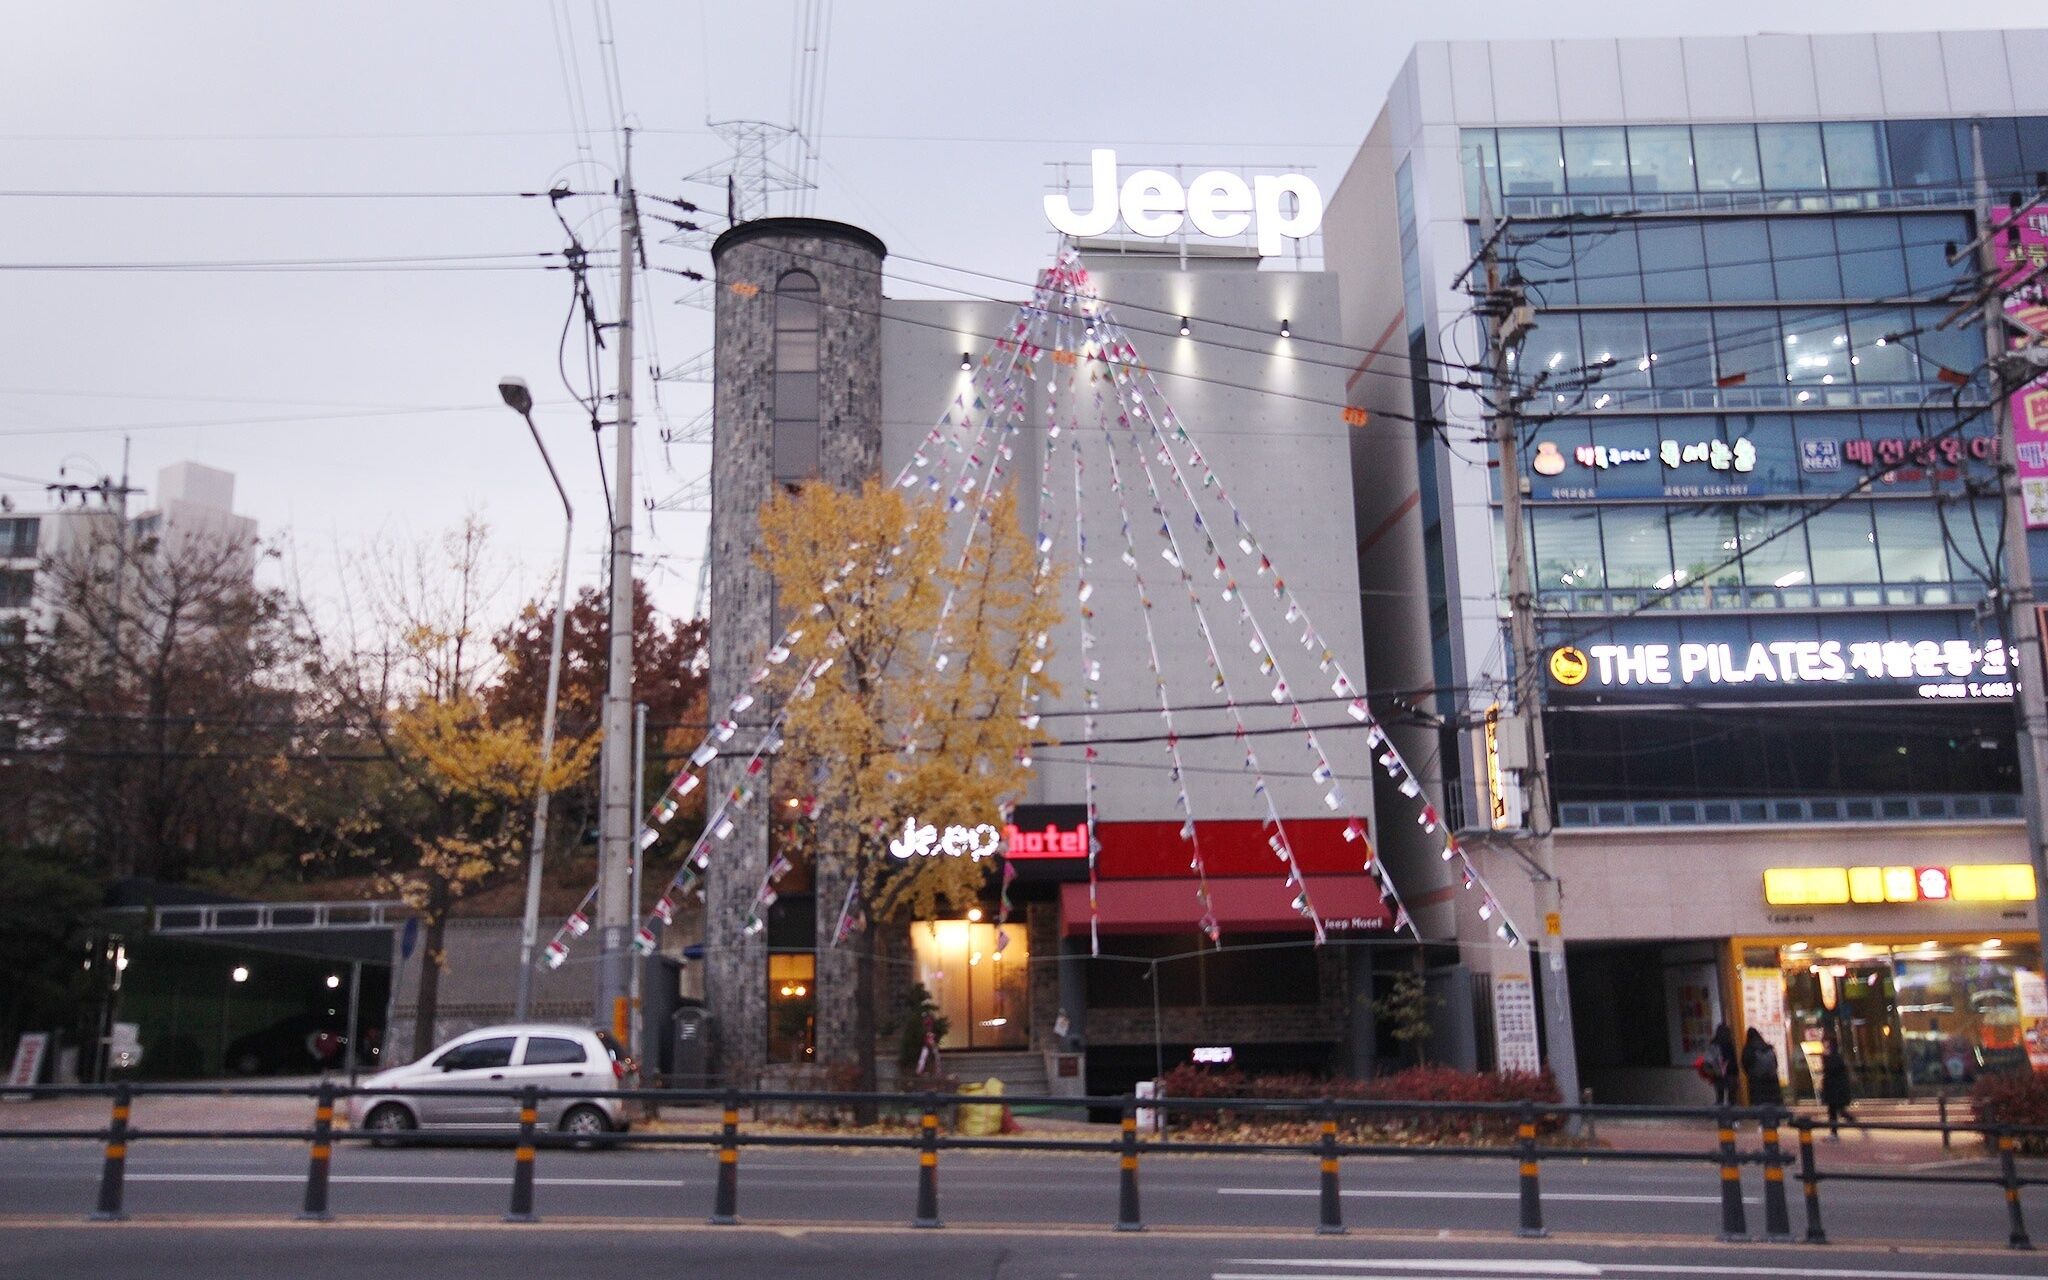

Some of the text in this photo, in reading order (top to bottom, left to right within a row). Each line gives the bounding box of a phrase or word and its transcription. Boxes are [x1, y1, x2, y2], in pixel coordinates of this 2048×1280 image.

[1043, 148, 1324, 257] Jeep
[1590, 644, 1671, 686] THE
[1679, 640, 1846, 684] PILATES
[889, 816, 1088, 862] Jeep hotel
